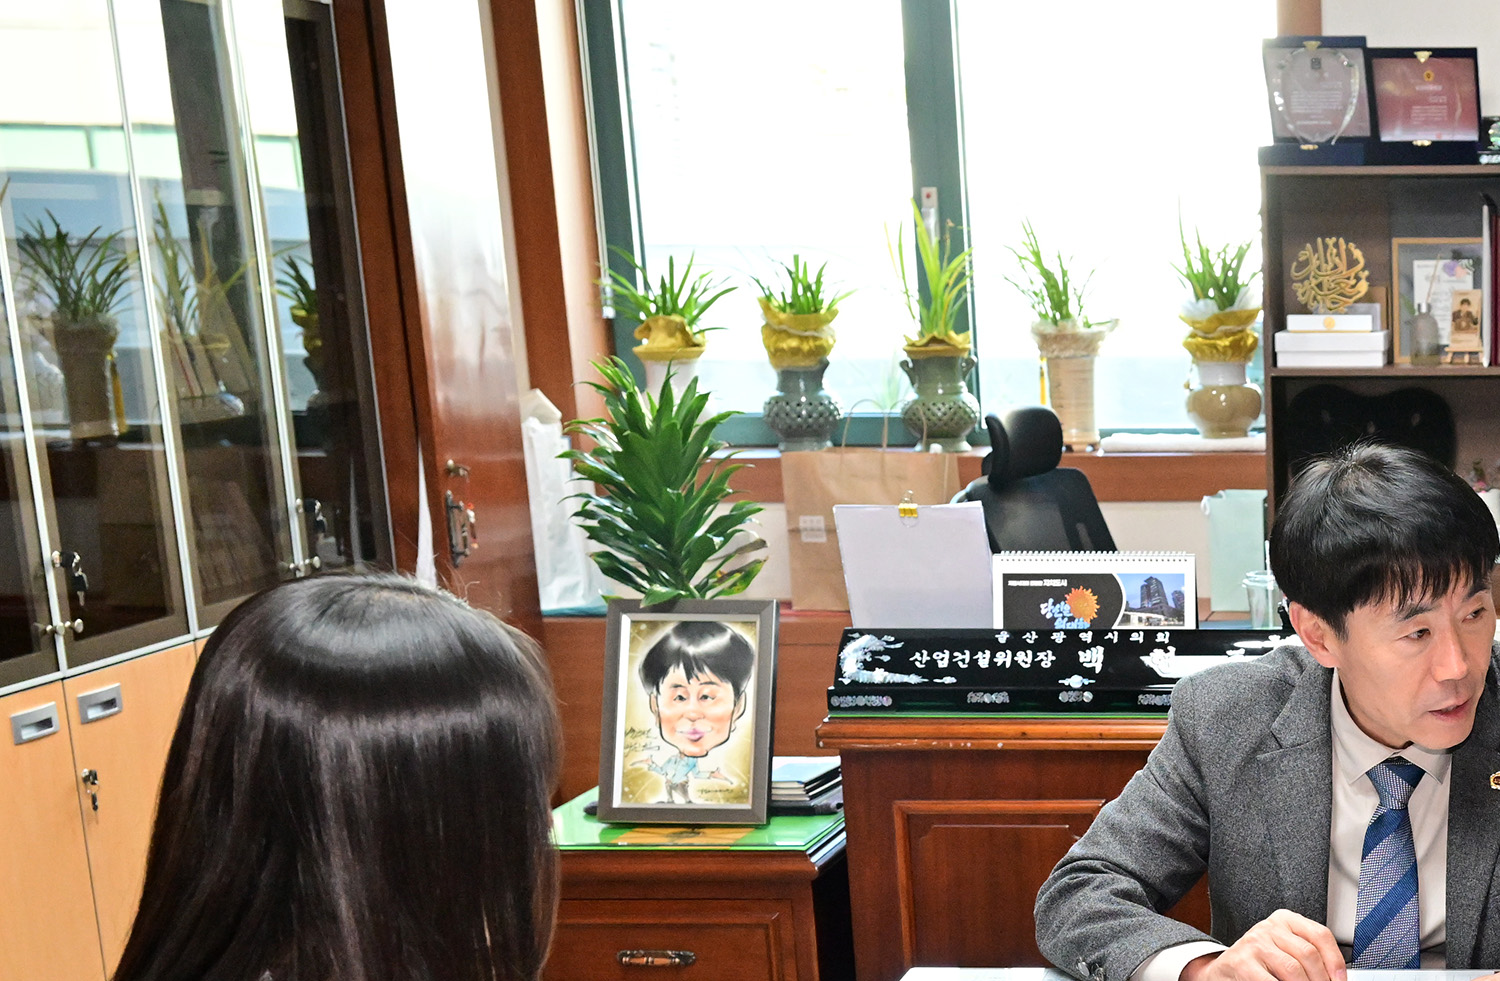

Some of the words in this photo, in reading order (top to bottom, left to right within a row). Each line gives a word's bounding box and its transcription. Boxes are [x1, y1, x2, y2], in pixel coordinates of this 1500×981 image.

[994, 630, 1170, 644] 울산광역시의회
[908, 649, 1056, 668] 산업건설위원장
[1078, 645, 1105, 674] 백
